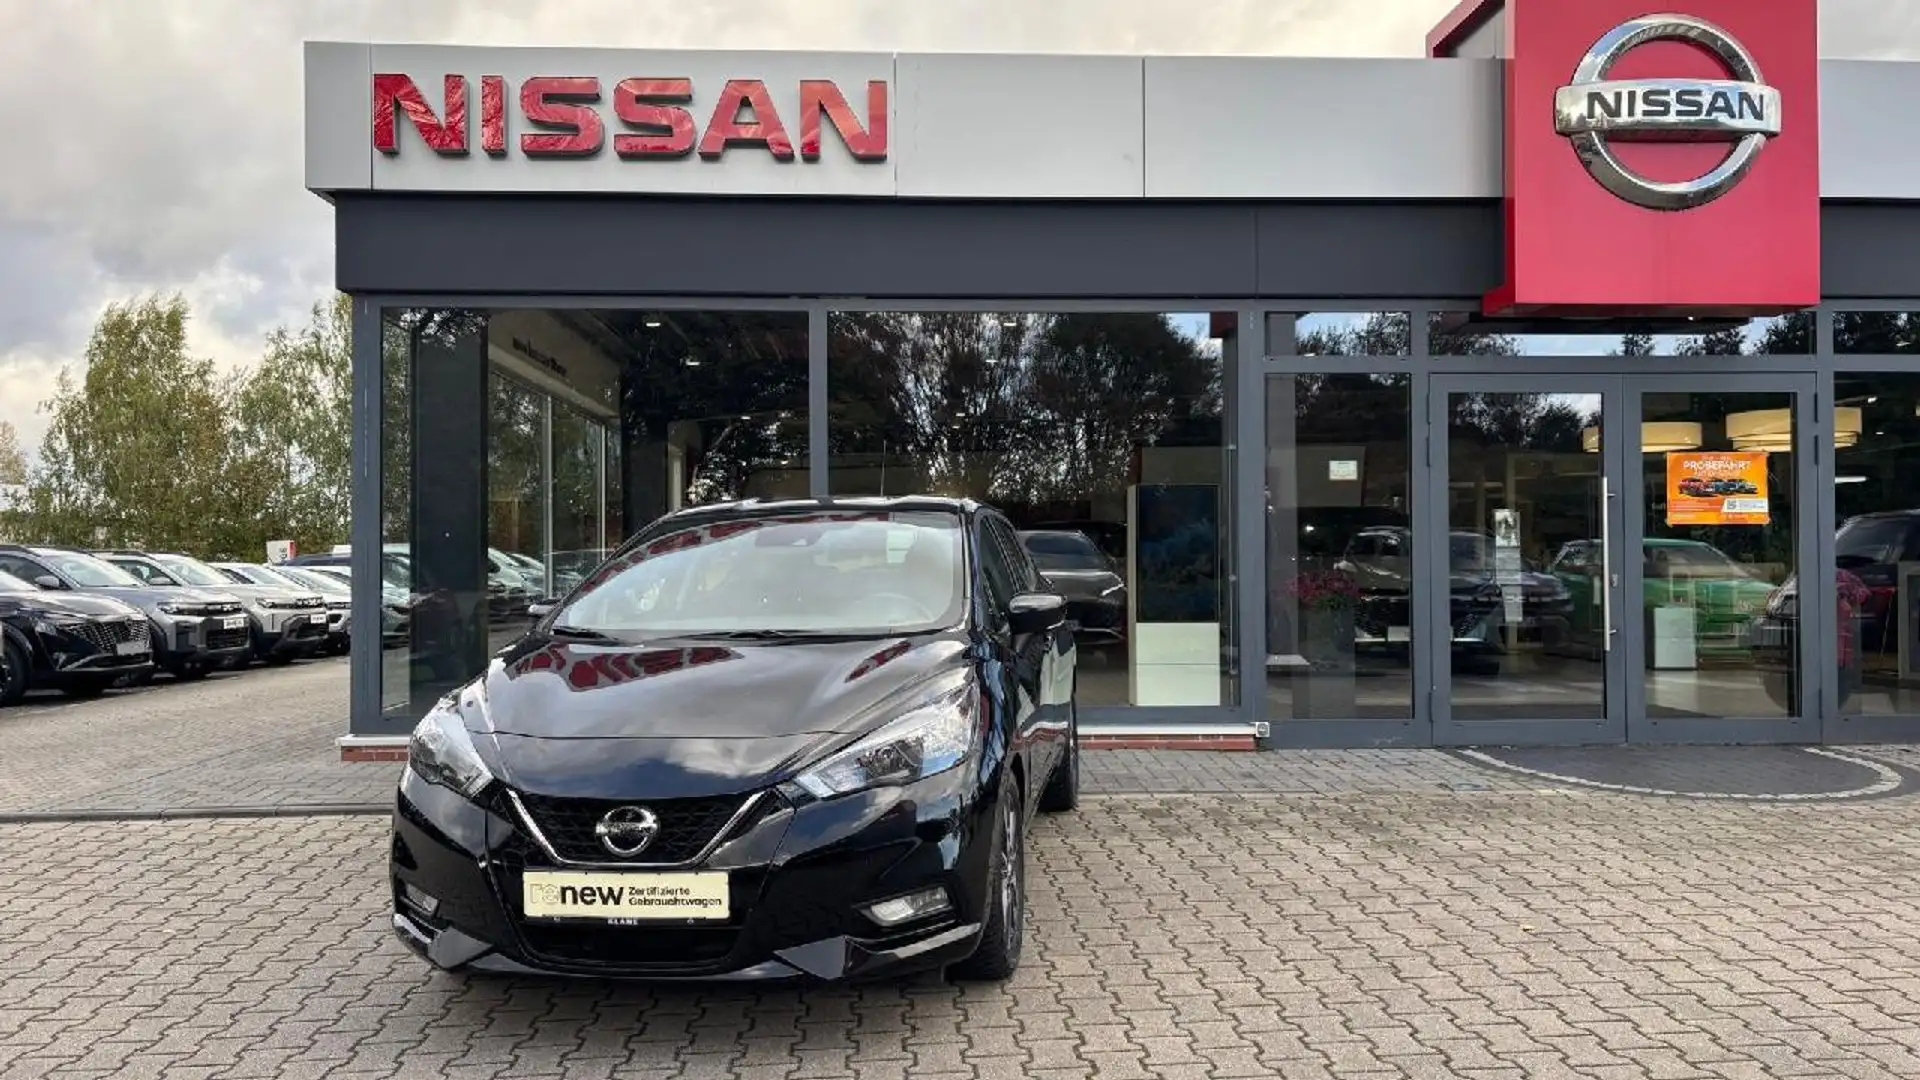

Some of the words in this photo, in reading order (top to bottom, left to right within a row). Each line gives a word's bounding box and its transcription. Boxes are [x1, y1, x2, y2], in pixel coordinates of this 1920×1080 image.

[373, 73, 889, 160] NISSAN
[1586, 89, 1764, 121] NISSAN
[529, 883, 625, 906] renew
[628, 886, 690, 896] Zertifizierte
[628, 896, 722, 908] Gebrauchtwagen
